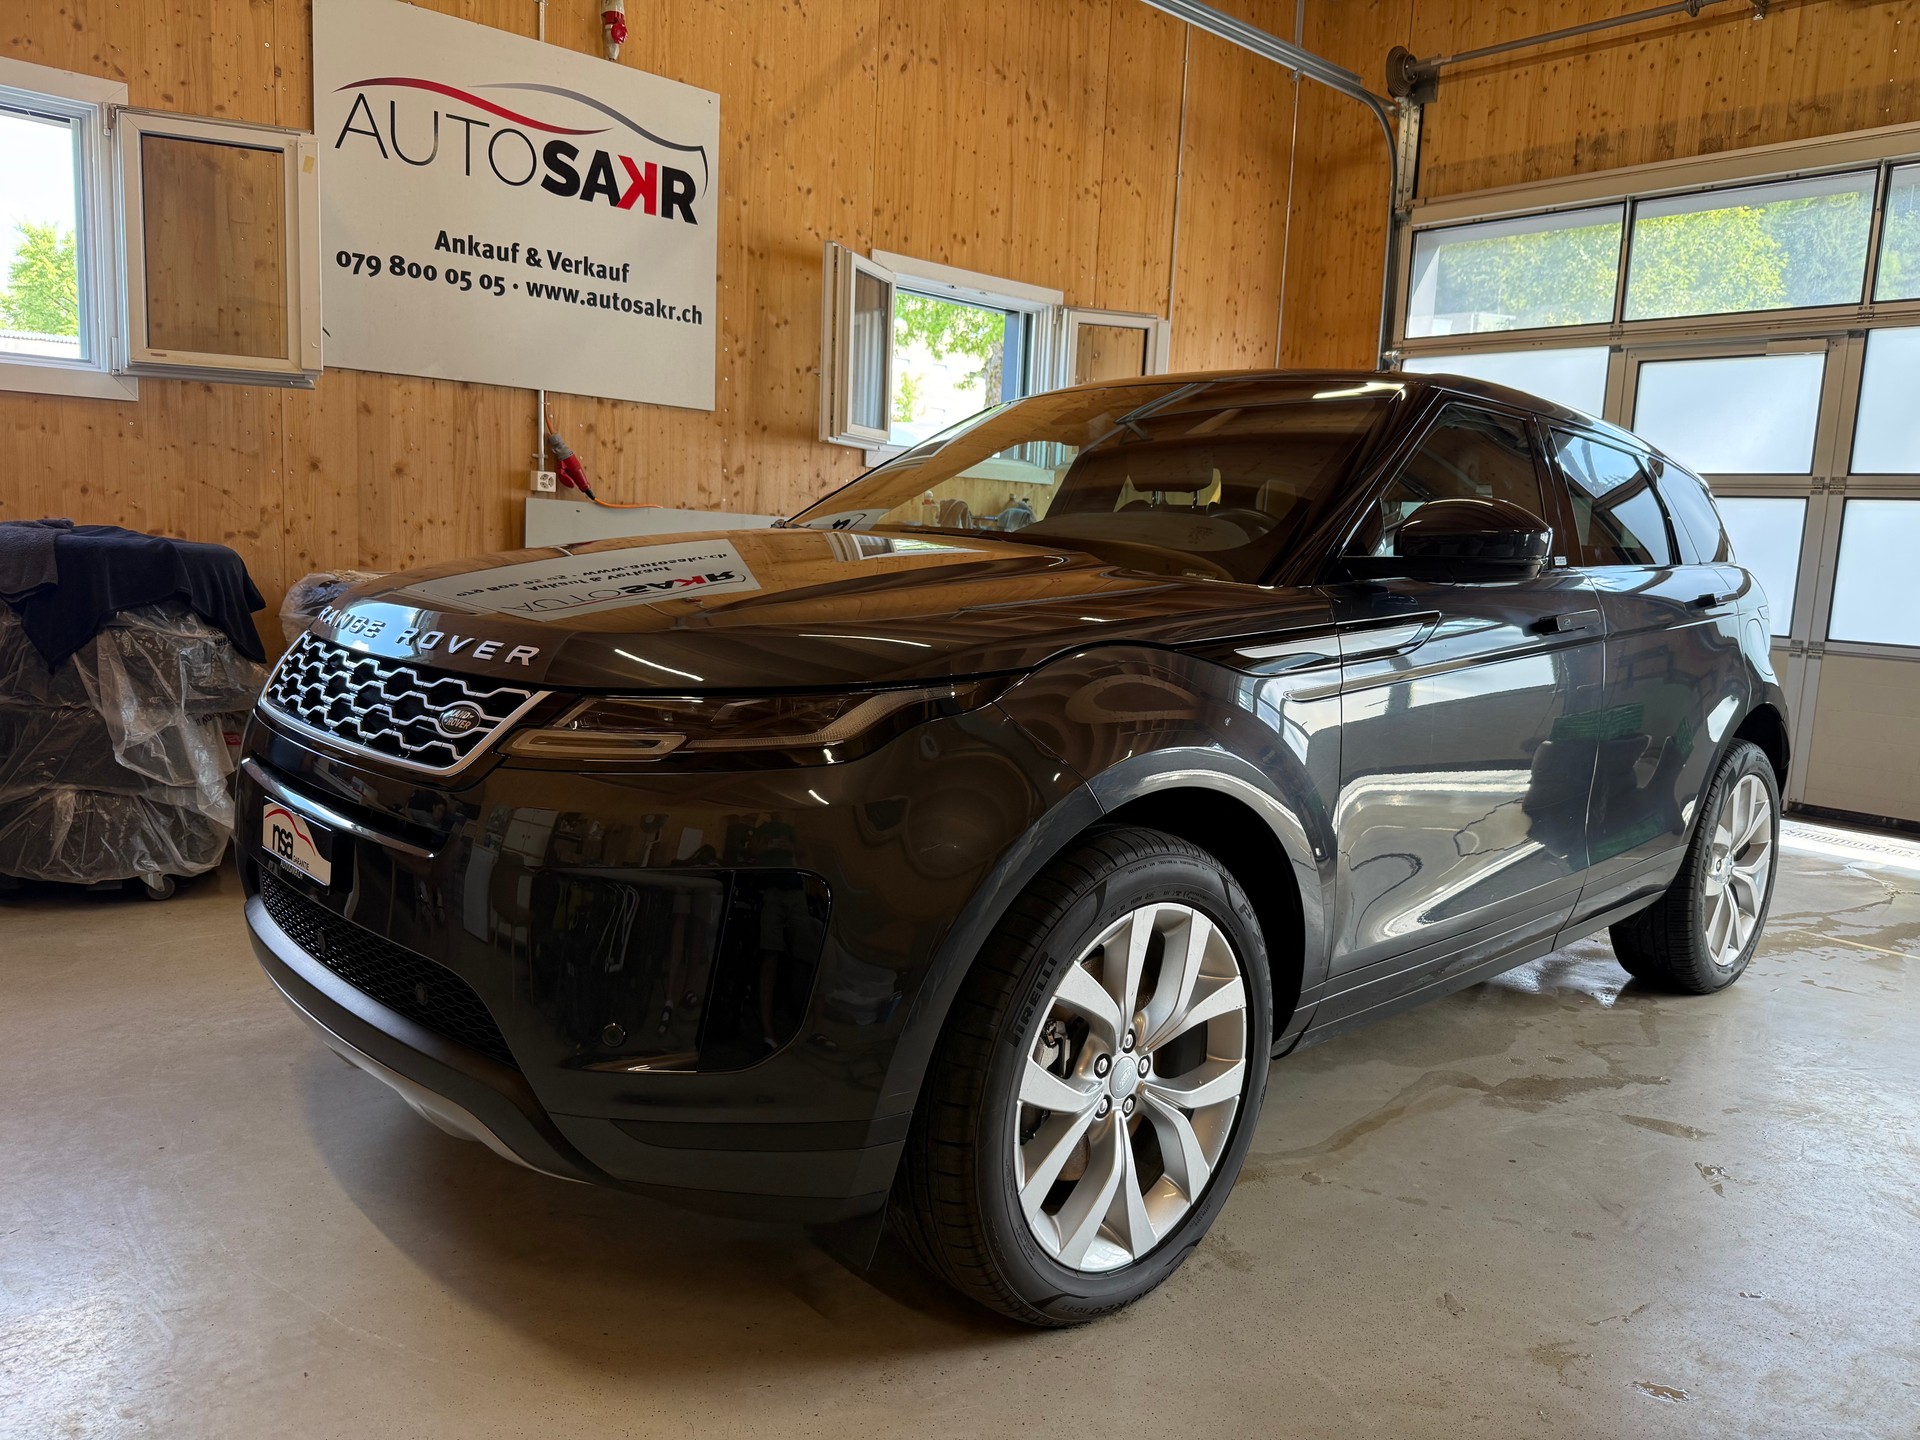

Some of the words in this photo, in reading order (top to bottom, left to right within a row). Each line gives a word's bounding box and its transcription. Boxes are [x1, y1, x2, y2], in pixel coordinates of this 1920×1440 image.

[335, 93, 698, 225] AUTOSAKR
[336, 250, 382, 277] 079
[389, 255, 437, 282] 800
[445, 267, 472, 291] 05
[480, 274, 506, 297] 05
[526, 279, 703, 325] www.autosakr.ch
[434, 230, 520, 264] Ankauf
[526, 248, 543, 268] &
[547, 250, 630, 284] Verkauf
[318, 604, 386, 639] RANGE
[395, 627, 540, 668] ROVER
[272, 823, 294, 861] nsa
[1003, 951, 1058, 1048] PIRELLI
